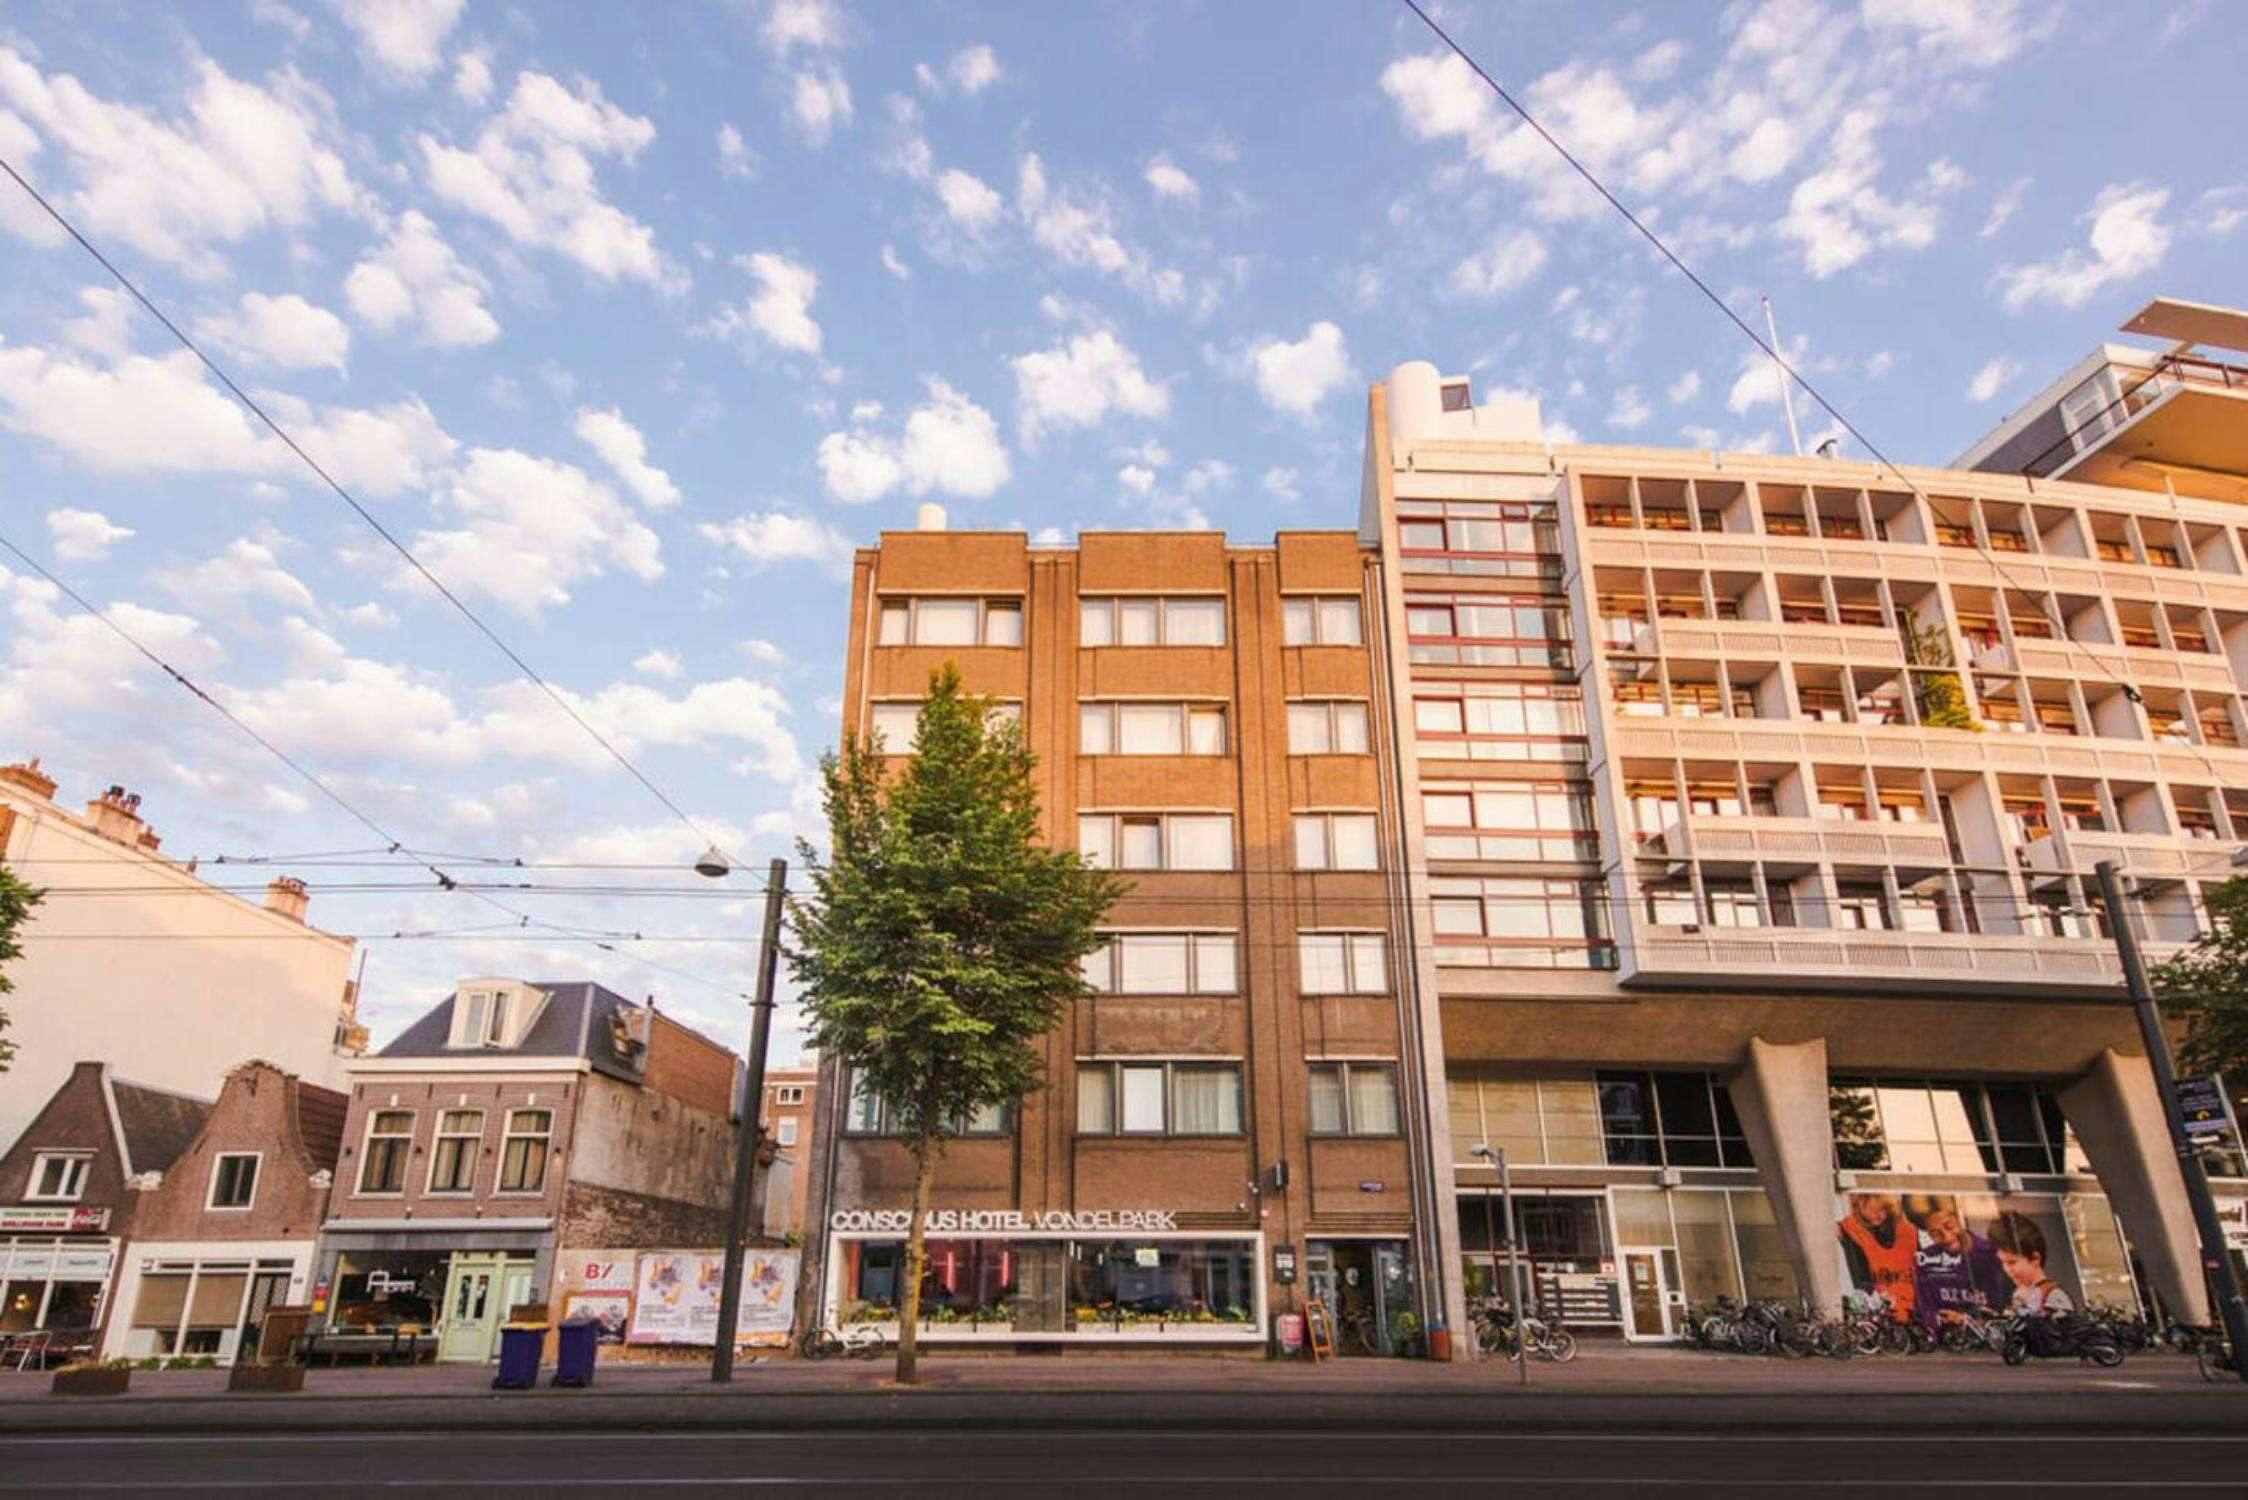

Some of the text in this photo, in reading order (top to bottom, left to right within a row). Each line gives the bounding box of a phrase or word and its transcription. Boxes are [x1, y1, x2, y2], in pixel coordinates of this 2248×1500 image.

[831, 1209, 1178, 1231] CONSCUS HOTEL VONDELPARK
